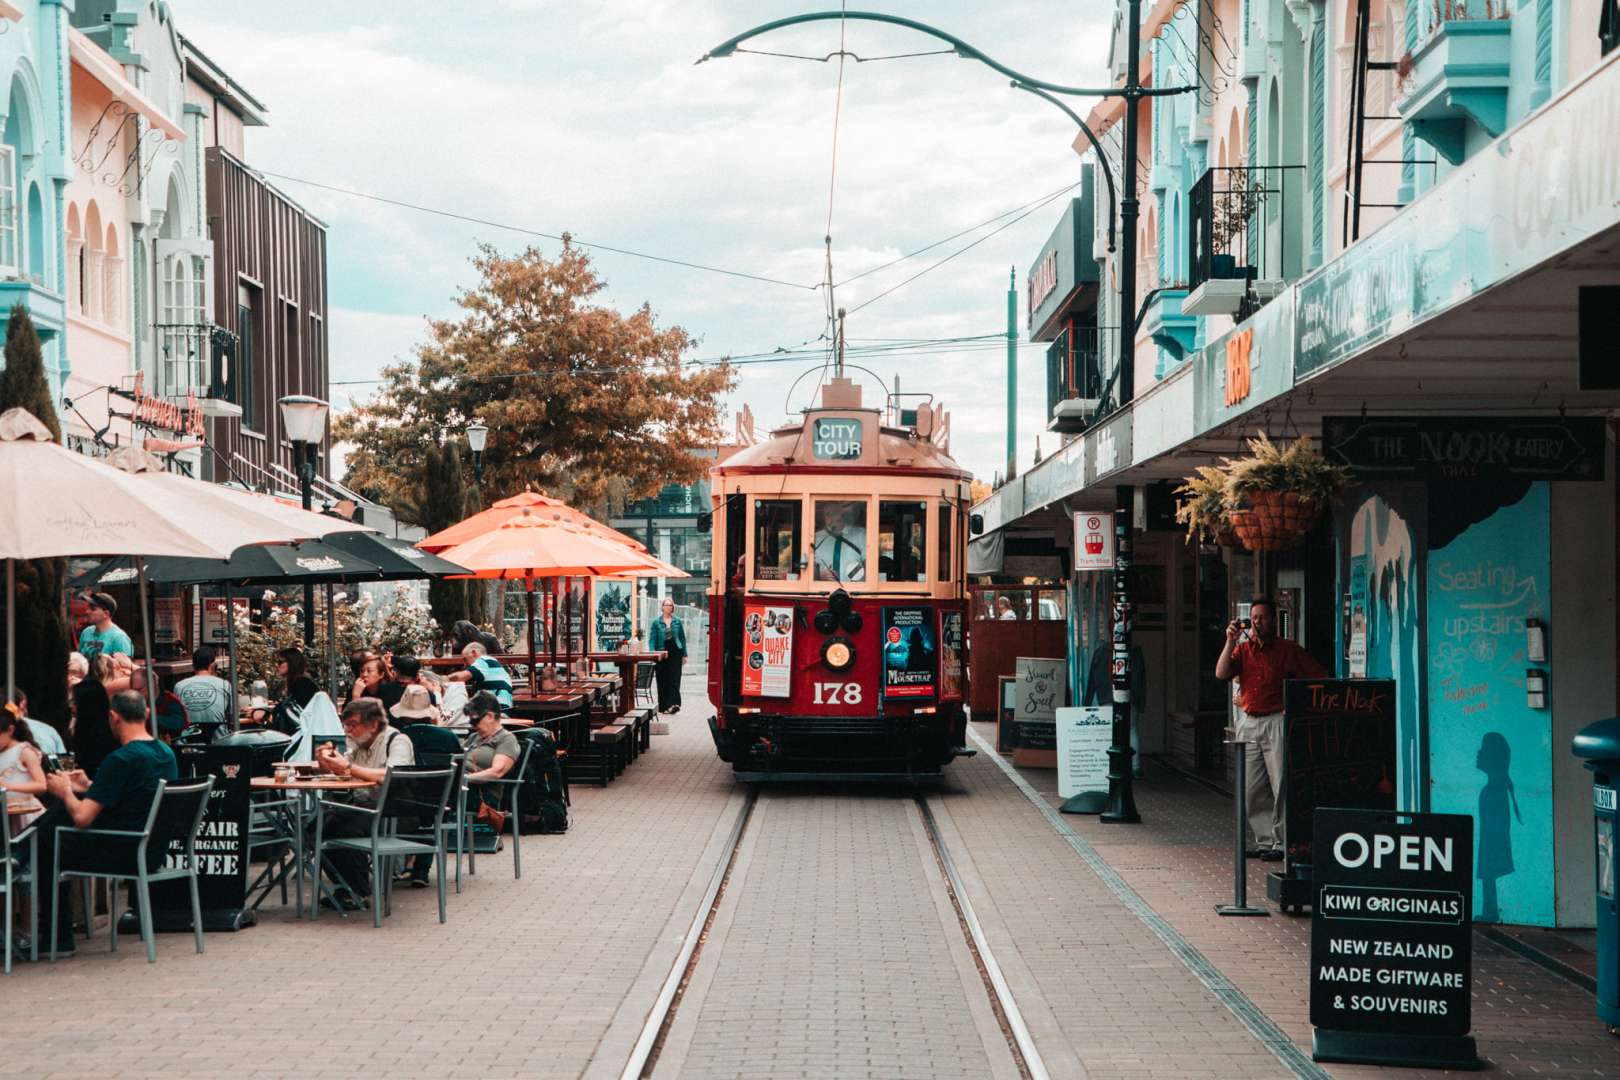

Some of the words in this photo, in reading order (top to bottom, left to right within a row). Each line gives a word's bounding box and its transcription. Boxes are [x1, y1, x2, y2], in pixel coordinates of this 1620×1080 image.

[819, 424, 857, 439] CITY
[814, 441, 861, 456] TOUR
[1369, 436, 1408, 459] THE
[1417, 431, 1511, 465] NOOK
[1514, 437, 1566, 458] EATERY
[1438, 562, 1516, 594] Seating
[601, 615, 625, 624] Autumn
[603, 624, 623, 632] Market
[1443, 611, 1525, 642] upstairs
[765, 637, 790, 651] QUAKE
[768, 651, 785, 665] CITY
[888, 670, 932, 685] MOUSETRAP
[812, 682, 863, 705] 178
[1304, 684, 1339, 711] The
[194, 840, 239, 850] RGANIC
[1332, 832, 1454, 872] OPEN
[1325, 894, 1361, 911] KIWI
[1366, 896, 1459, 916] ORIGINALS
[1329, 938, 1369, 955] NEW
[1373, 941, 1454, 960] ZEALAND
[1319, 965, 1372, 983] MADE
[1376, 968, 1464, 988] GIFTWARE
[1333, 995, 1345, 1010] &
[1350, 995, 1449, 1016] SOUVENIRS
